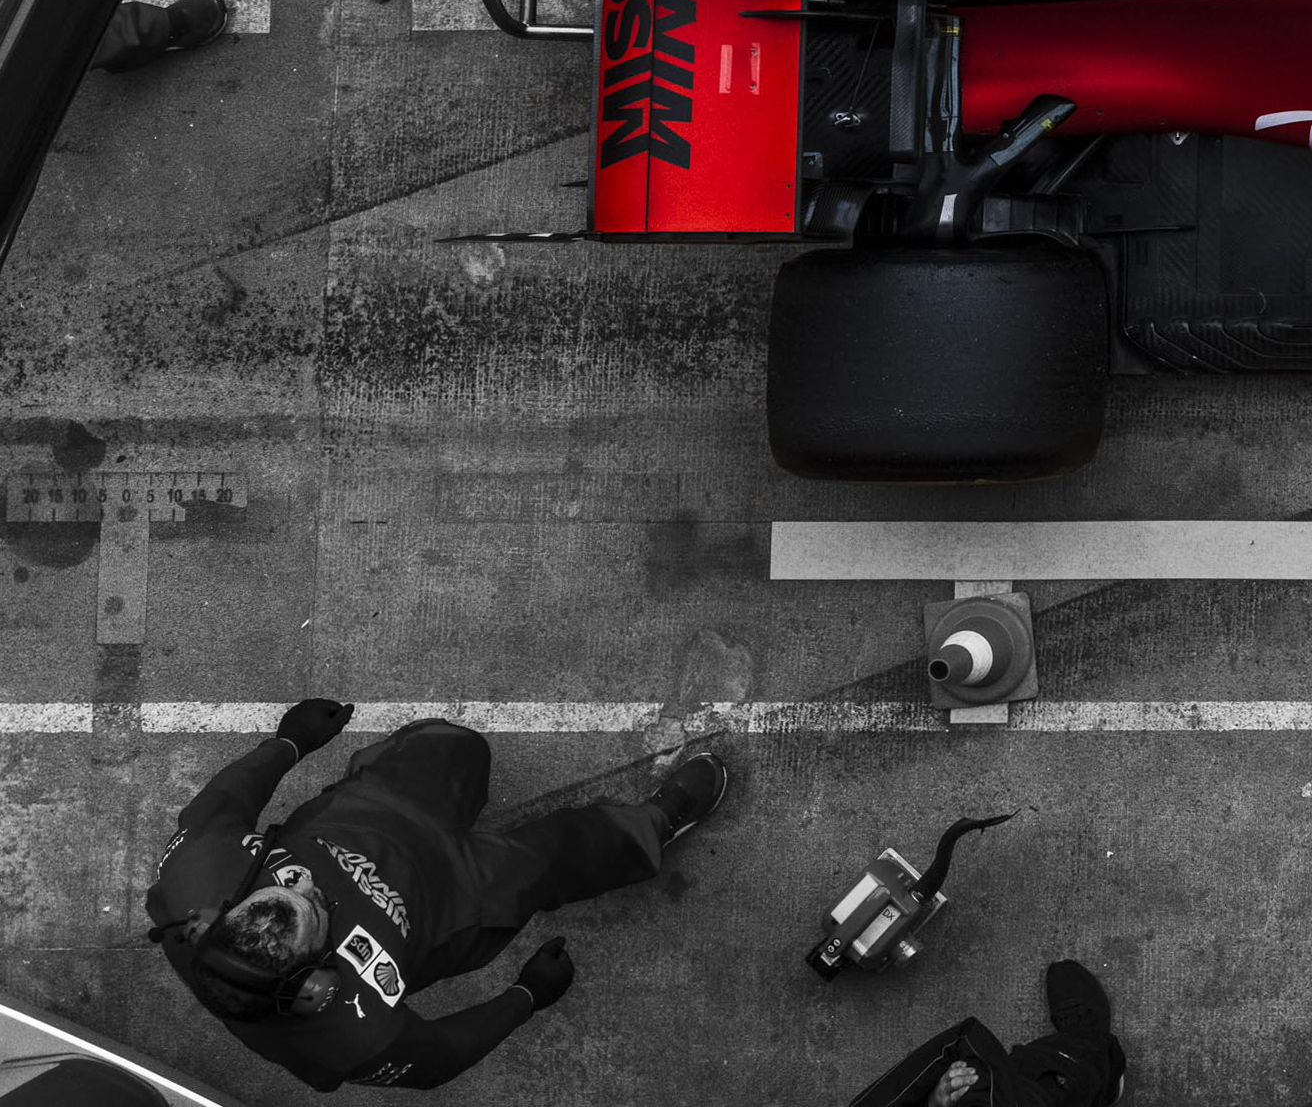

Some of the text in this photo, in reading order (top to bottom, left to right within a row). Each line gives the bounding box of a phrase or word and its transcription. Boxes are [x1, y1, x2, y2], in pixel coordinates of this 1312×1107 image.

[122, 489, 130, 503] 0
[147, 489, 155, 503] 5
[169, 489, 183, 503] 10
